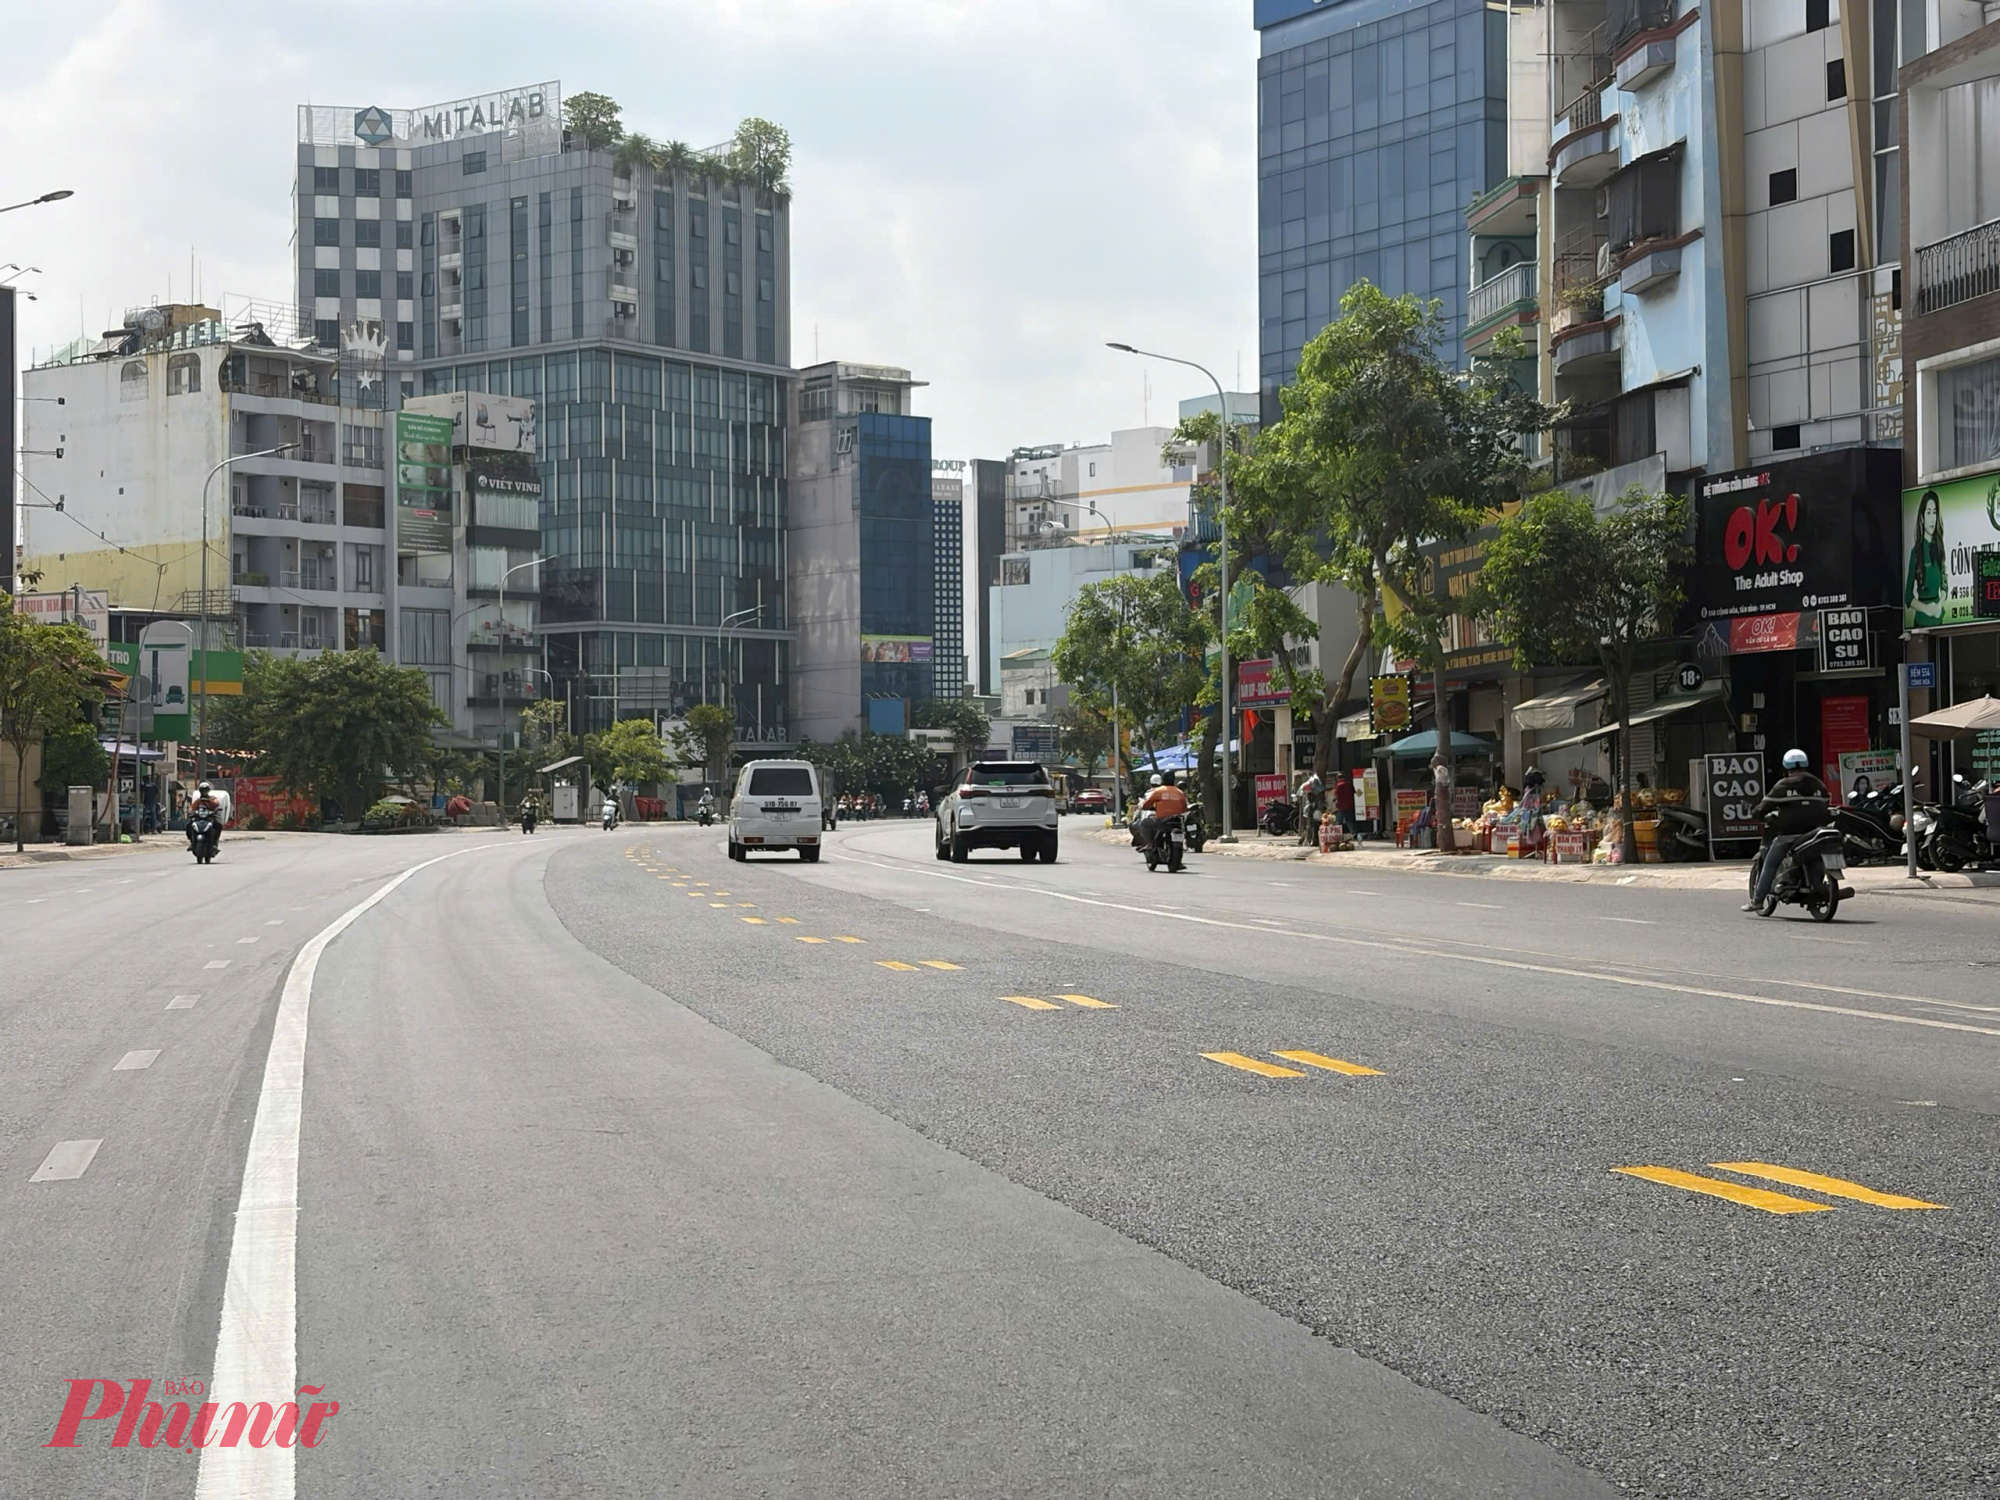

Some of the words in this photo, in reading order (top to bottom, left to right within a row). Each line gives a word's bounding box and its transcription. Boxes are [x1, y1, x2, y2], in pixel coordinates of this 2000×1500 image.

[424, 93, 545, 138] MITALAB
[515, 481, 541, 494] VINH
[1724, 493, 1801, 571] OK!
[1734, 575, 1753, 591] The
[1754, 571, 1779, 588] Adult
[1779, 569, 1804, 588] Shop
[1959, 586, 1970, 598] 556
[1751, 616, 1776, 636] OK!
[1828, 611, 1863, 626] BAO
[1828, 628, 1863, 642] CAO
[1835, 645, 1859, 658] SU
[1680, 670, 1701, 686] 18+
[1712, 757, 1759, 775] BAO
[1713, 780, 1760, 797] CAO
